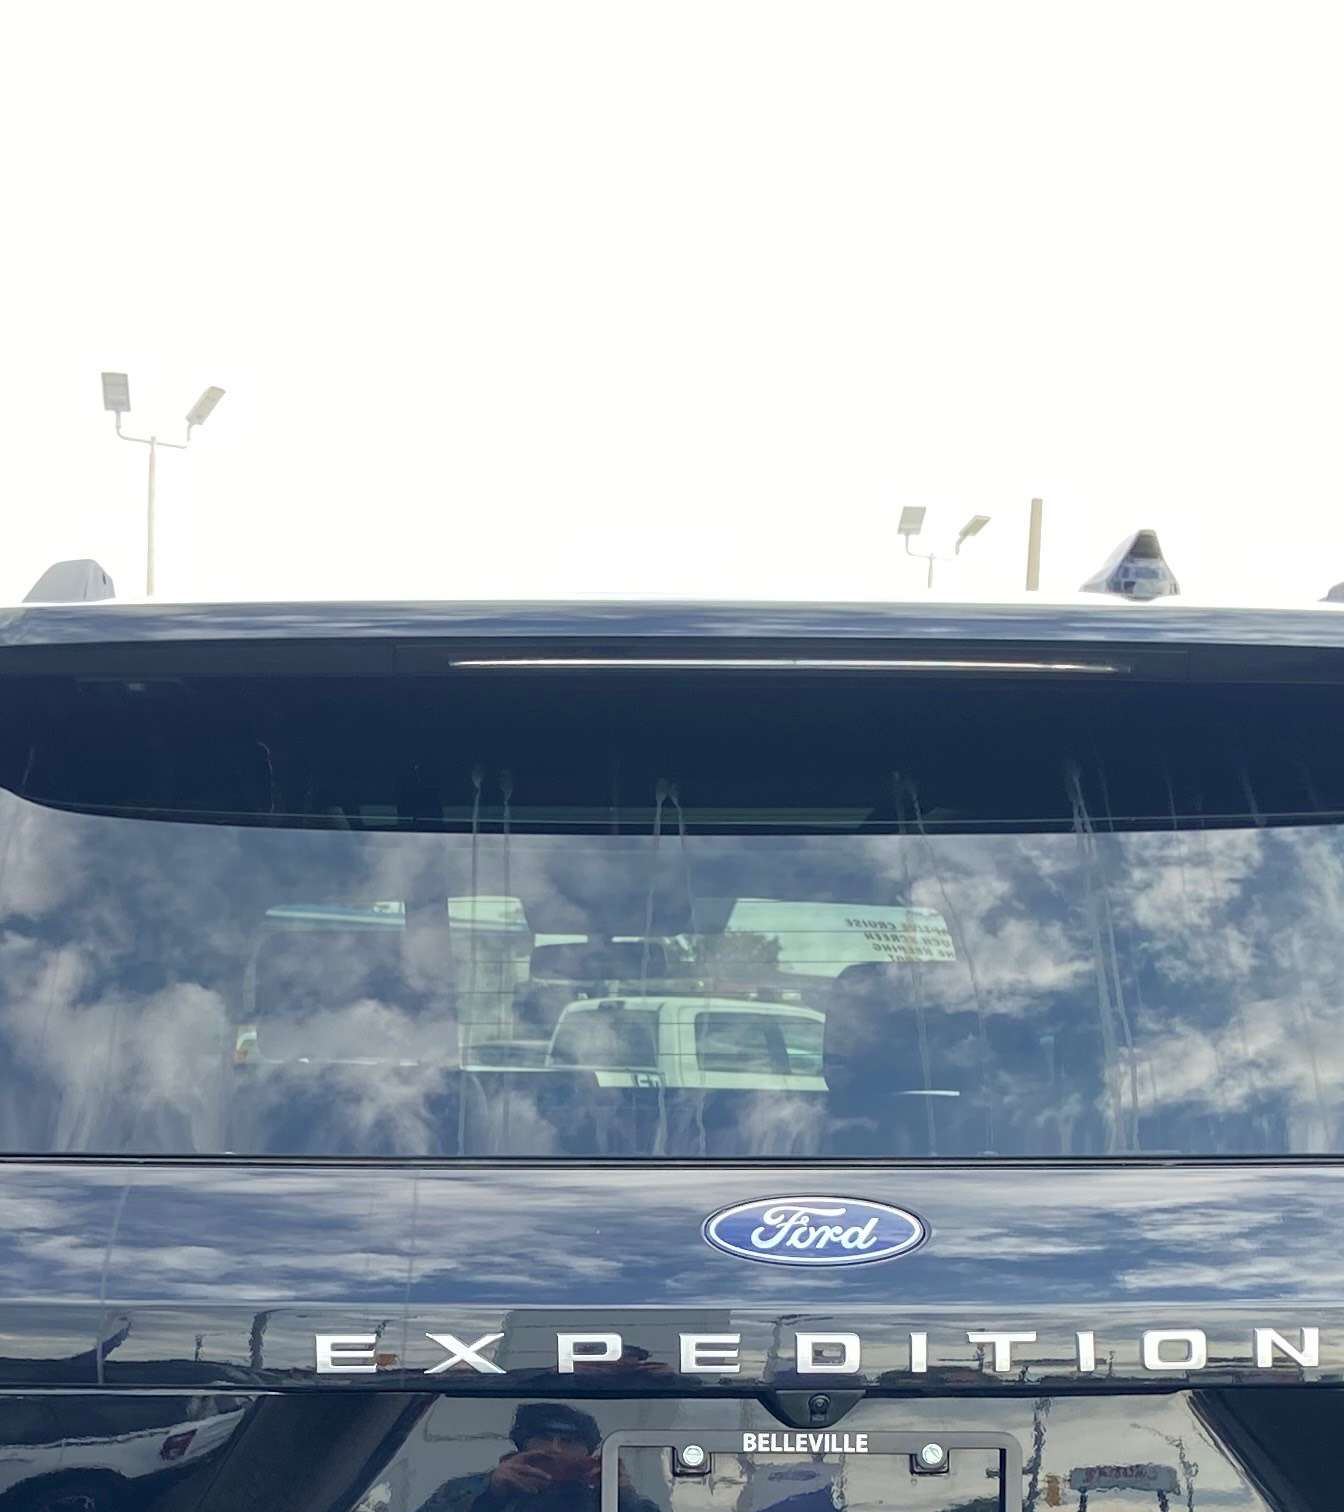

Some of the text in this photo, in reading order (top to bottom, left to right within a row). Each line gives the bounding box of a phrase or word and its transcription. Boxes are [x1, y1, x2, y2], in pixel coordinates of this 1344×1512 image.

[750, 1205, 880, 1250] Ford
[314, 1326, 1321, 1375] EXPEDITION
[742, 1432, 869, 1454] BELLEVILLE
